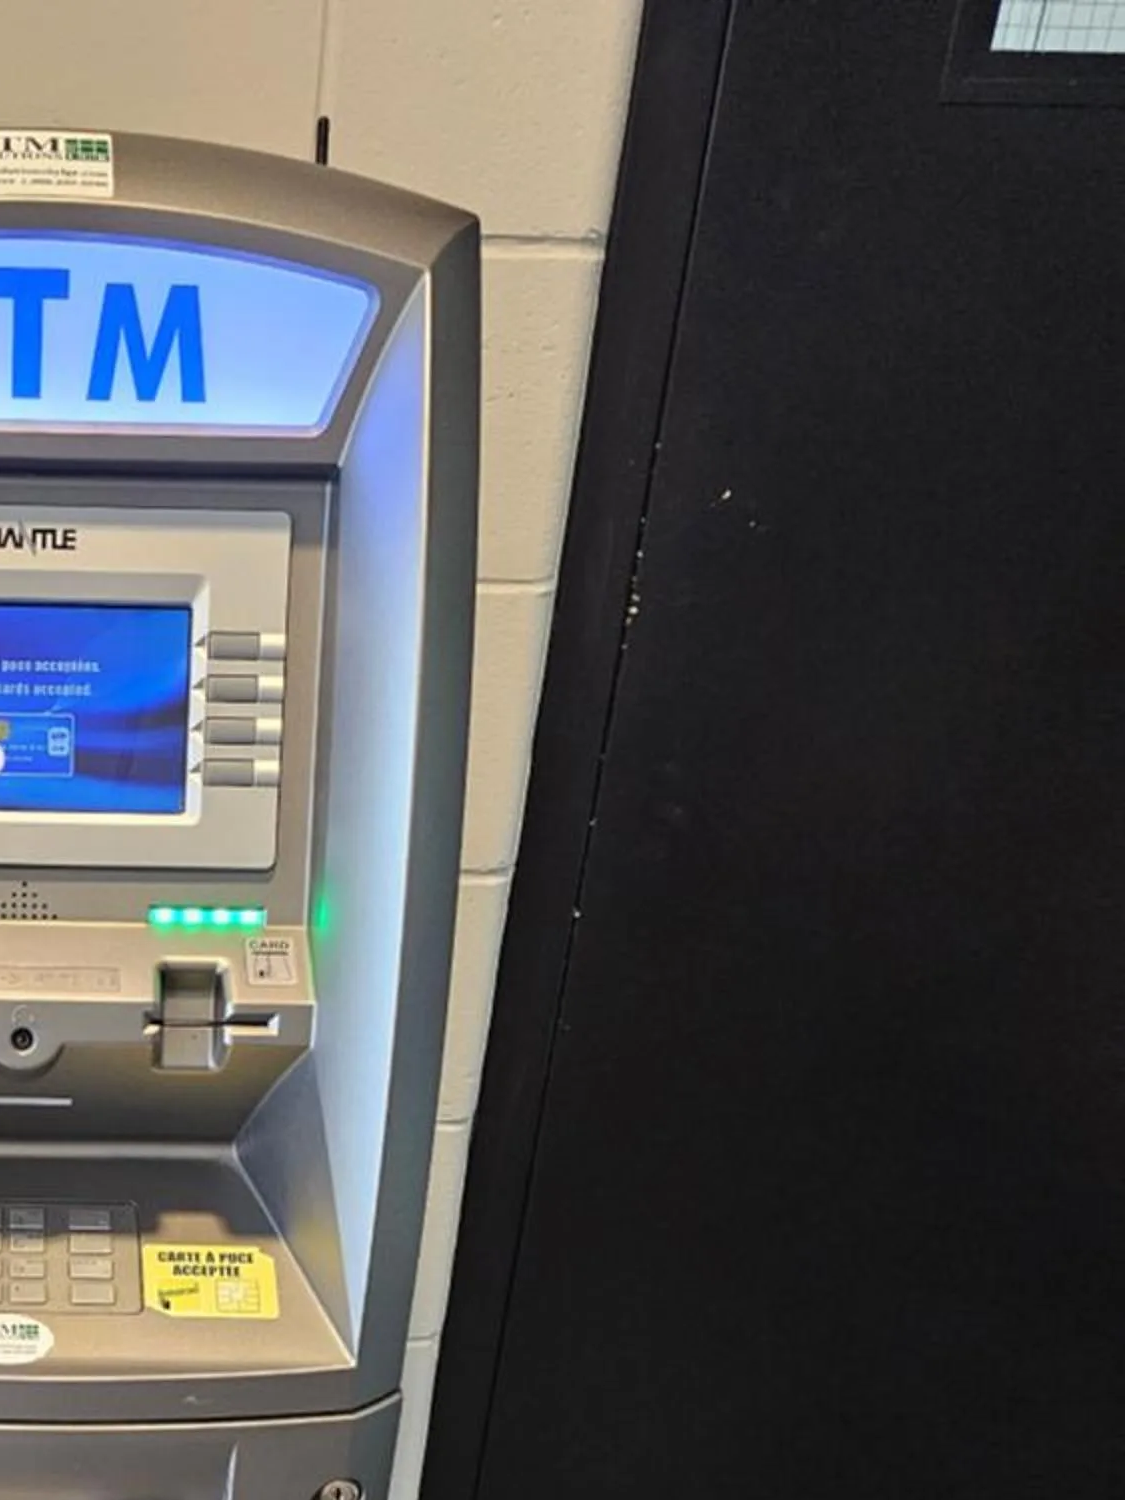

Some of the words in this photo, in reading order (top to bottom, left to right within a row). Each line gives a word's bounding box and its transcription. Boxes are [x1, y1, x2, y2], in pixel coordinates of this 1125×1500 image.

[249, 940, 289, 950] CARD
[157, 1251, 201, 1263] CARTE
[218, 1252, 254, 1264] PUCE
